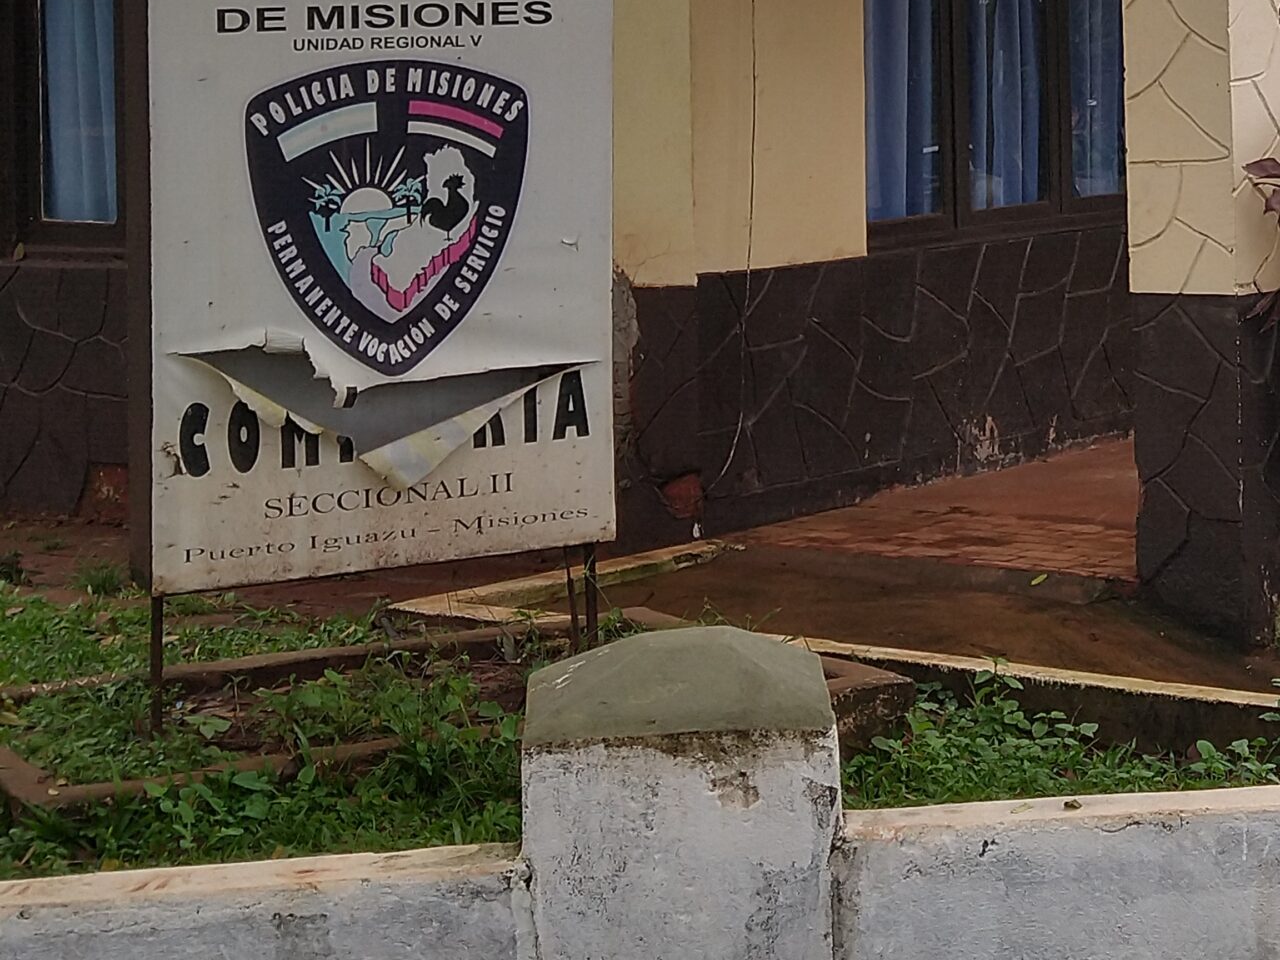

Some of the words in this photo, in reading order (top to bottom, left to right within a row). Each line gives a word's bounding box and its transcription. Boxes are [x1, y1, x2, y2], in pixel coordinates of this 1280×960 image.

[216, 6, 287, 34] DE
[306, 0, 554, 31] MISIONES
[293, 38, 365, 52] UNIDAD
[370, 35, 465, 50] REGIONAL
[470, 35, 483, 48] V
[250, 73, 355, 137] POLICIA
[366, 68, 397, 94] DE
[407, 67, 525, 123] MISIONES
[267, 219, 359, 343] PERMANENTE
[357, 318, 437, 365] VOCACIÓN
[433, 293, 460, 322] DE
[454, 204, 507, 295] SERVICIO
[264, 478, 479, 519] SECCIONAL
[489, 472, 513, 494] II
[184, 541, 296, 564] Puerto
[309, 528, 416, 553] Iguazu
[453, 506, 589, 535] Misiones
